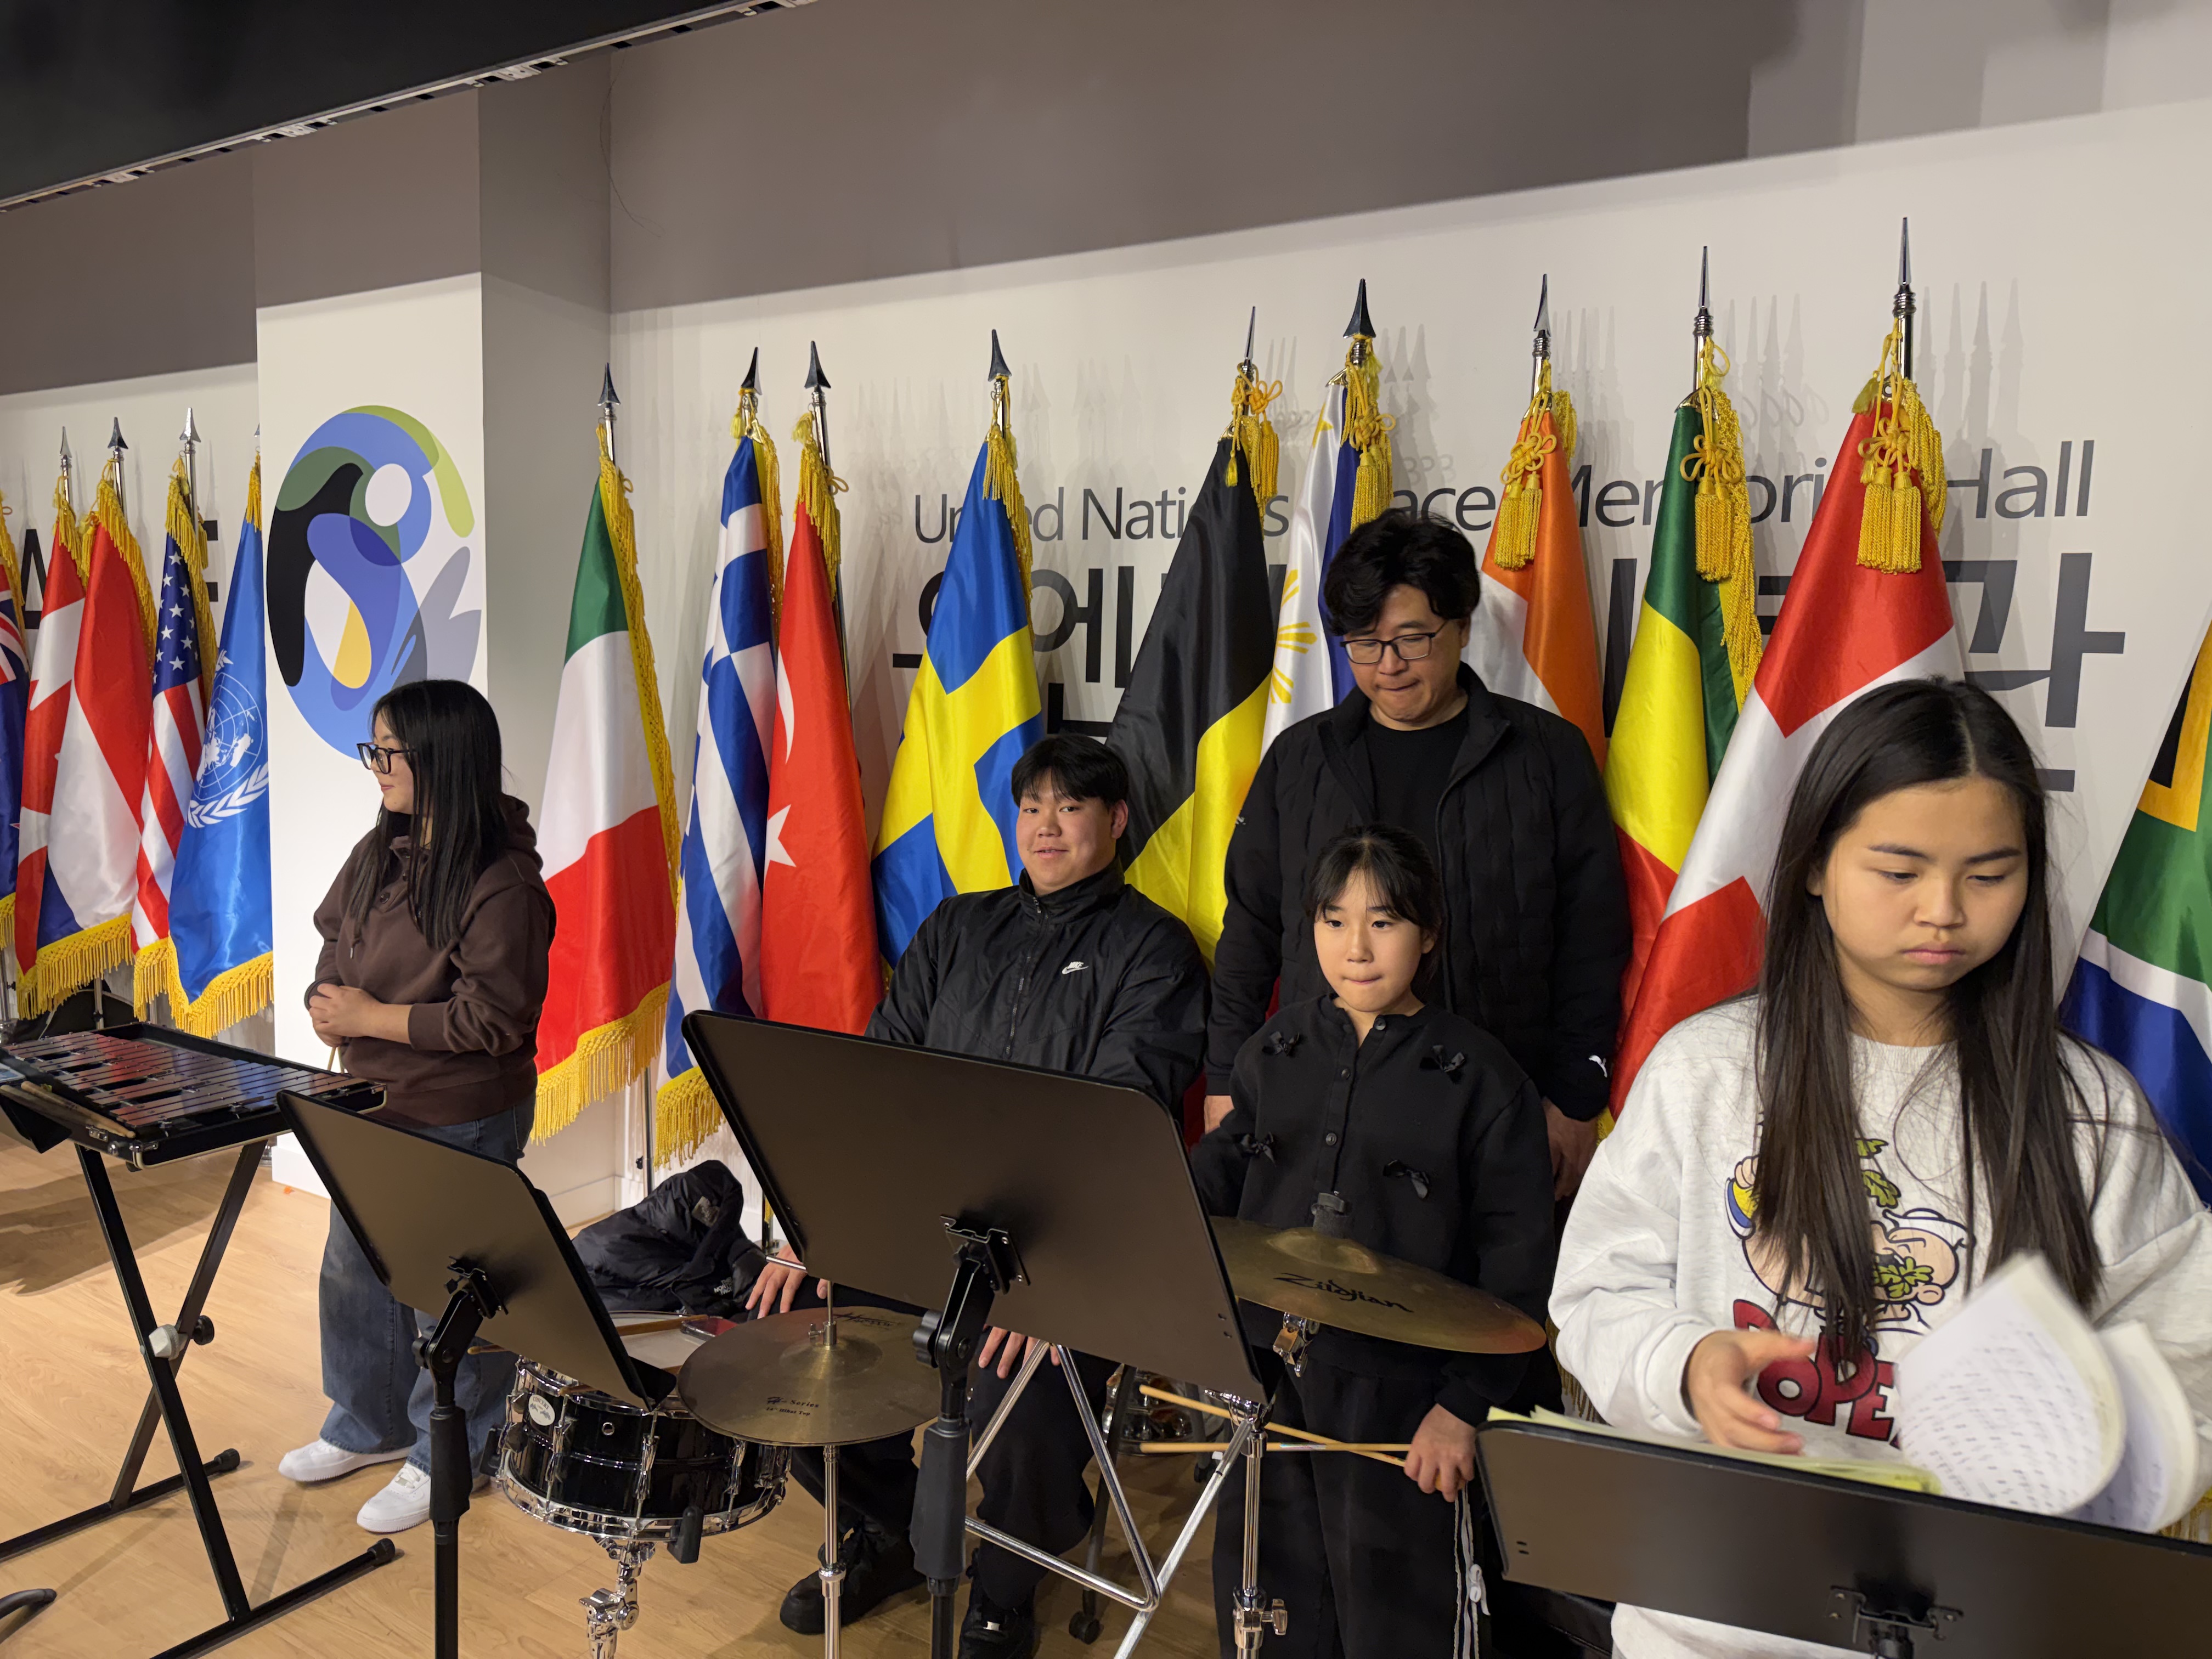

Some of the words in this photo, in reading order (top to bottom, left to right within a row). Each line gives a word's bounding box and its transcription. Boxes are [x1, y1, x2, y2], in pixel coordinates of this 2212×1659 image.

[1082, 487, 1290, 540] Natis
[1393, 486, 1496, 531] ace
[1946, 439, 2095, 518] Hall
[1066, 961, 1084, 969] NIKE
[1273, 1273, 1414, 1313] Zildjian
[1733, 1299, 1903, 1451] OPE
[533, 1396, 550, 1410] CONCERT
[791, 1400, 819, 1408] Series
